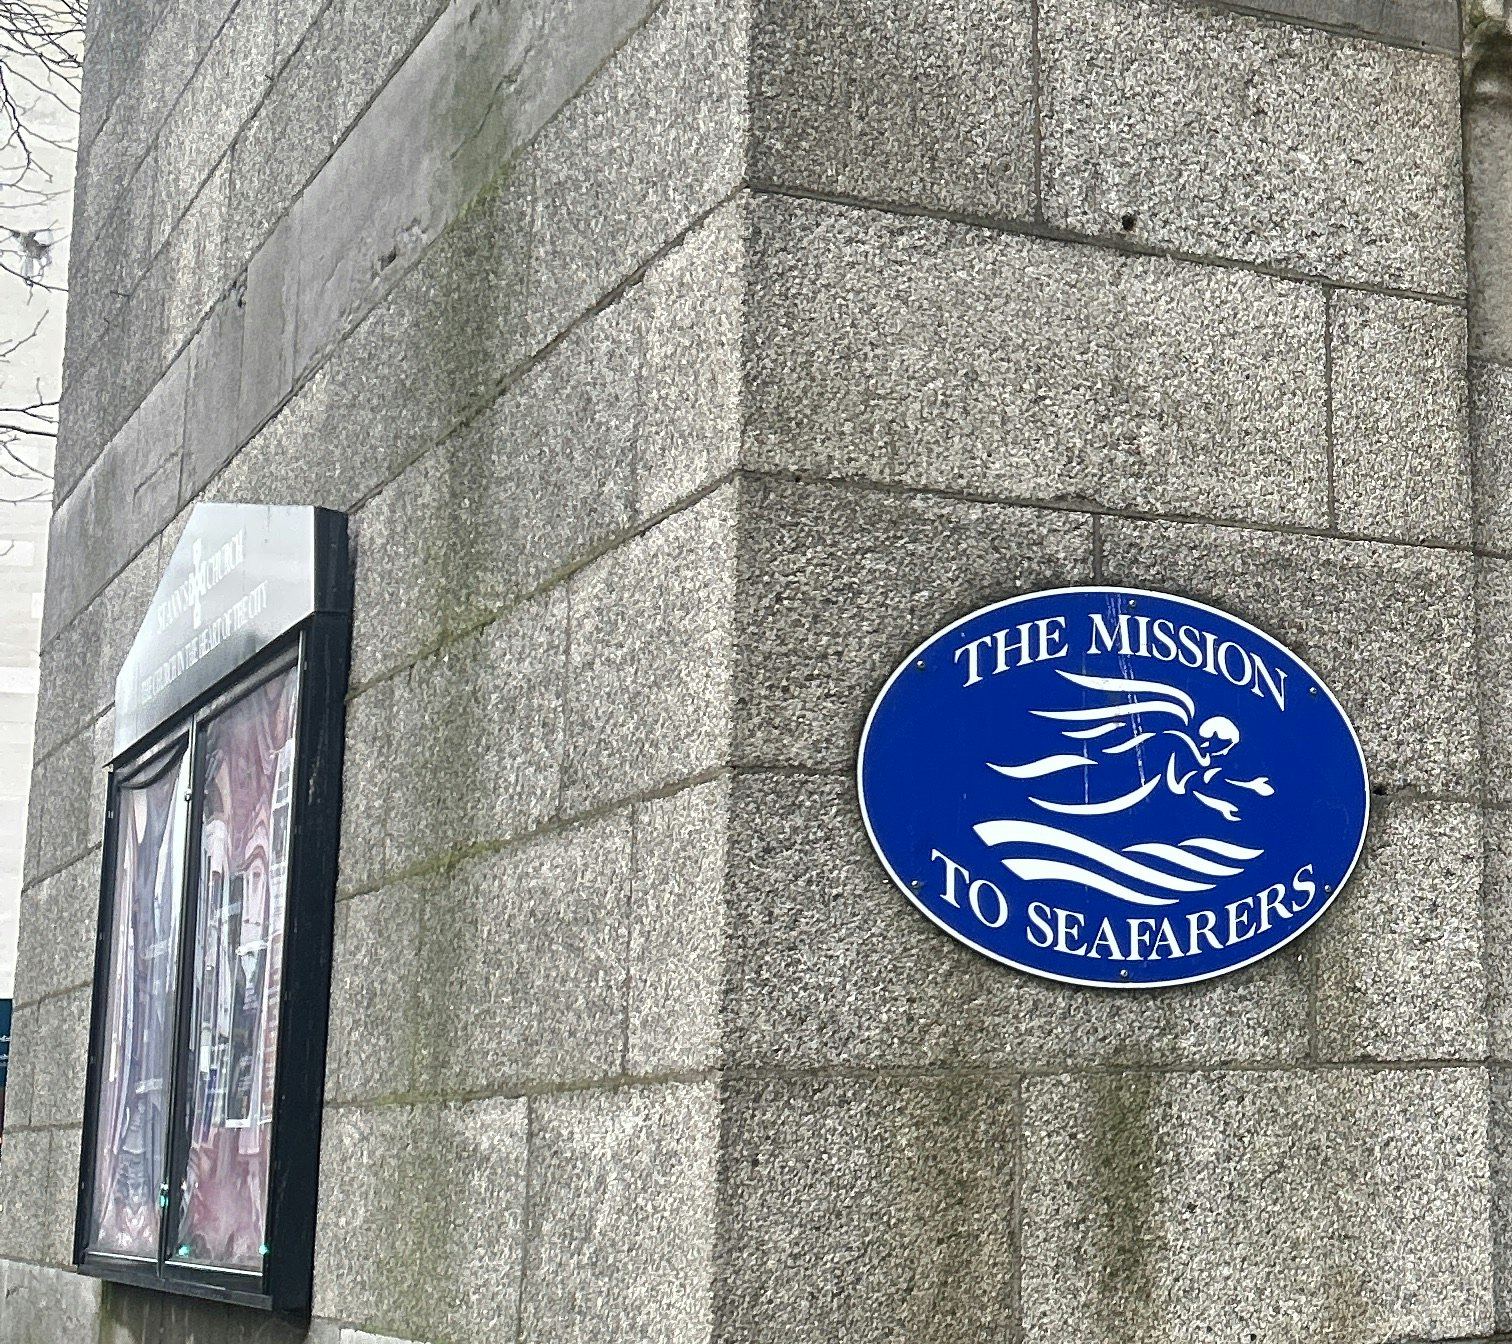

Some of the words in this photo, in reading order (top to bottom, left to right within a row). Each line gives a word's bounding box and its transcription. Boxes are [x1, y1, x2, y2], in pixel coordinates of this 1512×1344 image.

[954, 616, 1069, 688] THE
[1086, 613, 1288, 712] MISSION
[931, 848, 1009, 928] TO
[1026, 863, 1316, 961] SEAFARERS
